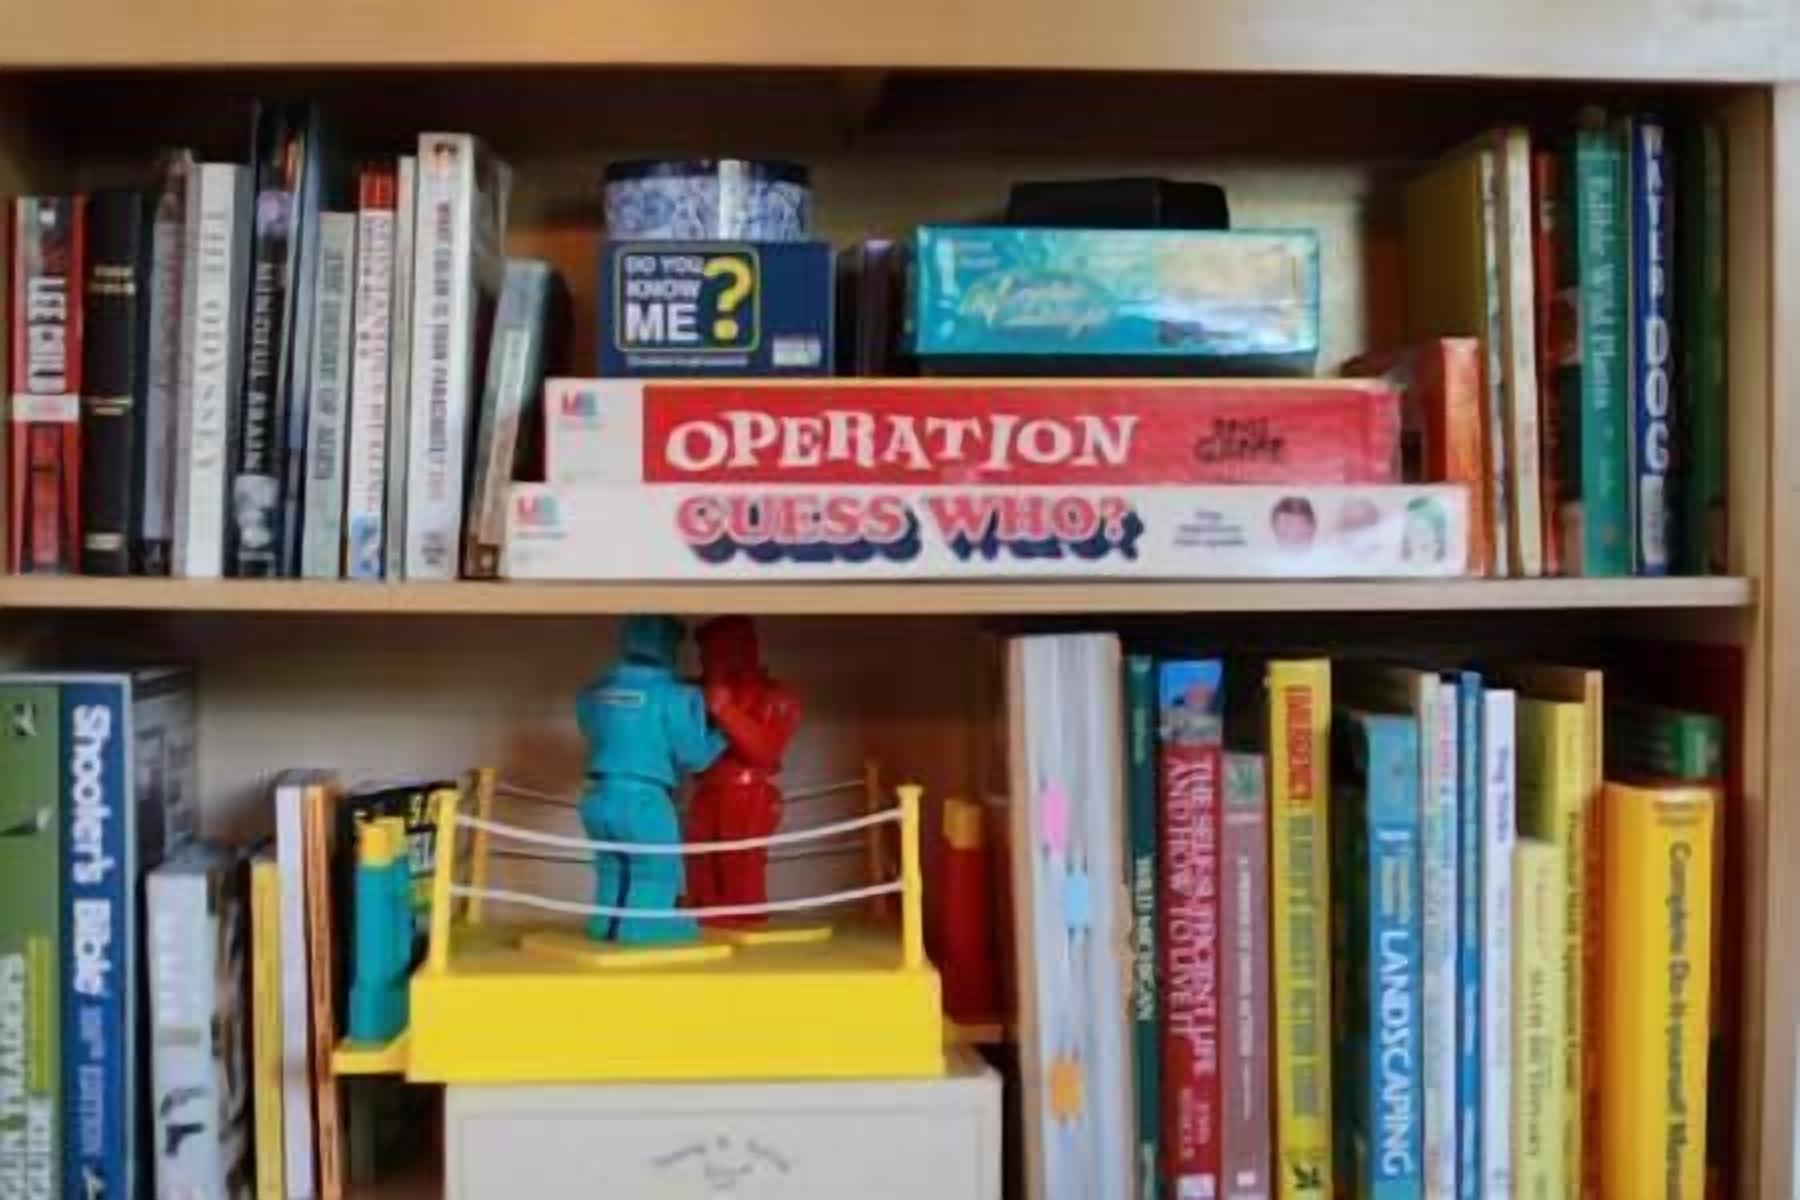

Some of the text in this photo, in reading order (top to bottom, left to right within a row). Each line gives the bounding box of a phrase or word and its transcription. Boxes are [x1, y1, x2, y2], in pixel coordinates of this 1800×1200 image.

[28, 277, 67, 321] LEE
[624, 256, 703, 274] DO YOU
[625, 279, 701, 298] KNOW
[625, 255, 751, 341] ME ?
[1586, 173, 1618, 411] Edible Wild Plants
[1642, 124, 1671, 471] WATER DOG
[28, 324, 67, 393] CHILD
[193, 211, 227, 472] THE ODYSSEY
[665, 410, 1138, 472] OPERATION
[676, 496, 919, 556] GUESS
[927, 496, 1143, 558] WHO?
[72, 704, 116, 885] Shooter's
[1168, 756, 1194, 821] AND
[1169, 826, 1194, 895] HOW
[1169, 904, 1194, 942] TO
[1664, 841, 1692, 954] Complete
[72, 898, 112, 996] Bible
[1134, 914, 1155, 1022] MICHIGAN
[1169, 948, 1194, 1006] LIVE
[1378, 930, 1413, 1178] LANDSCAPING
